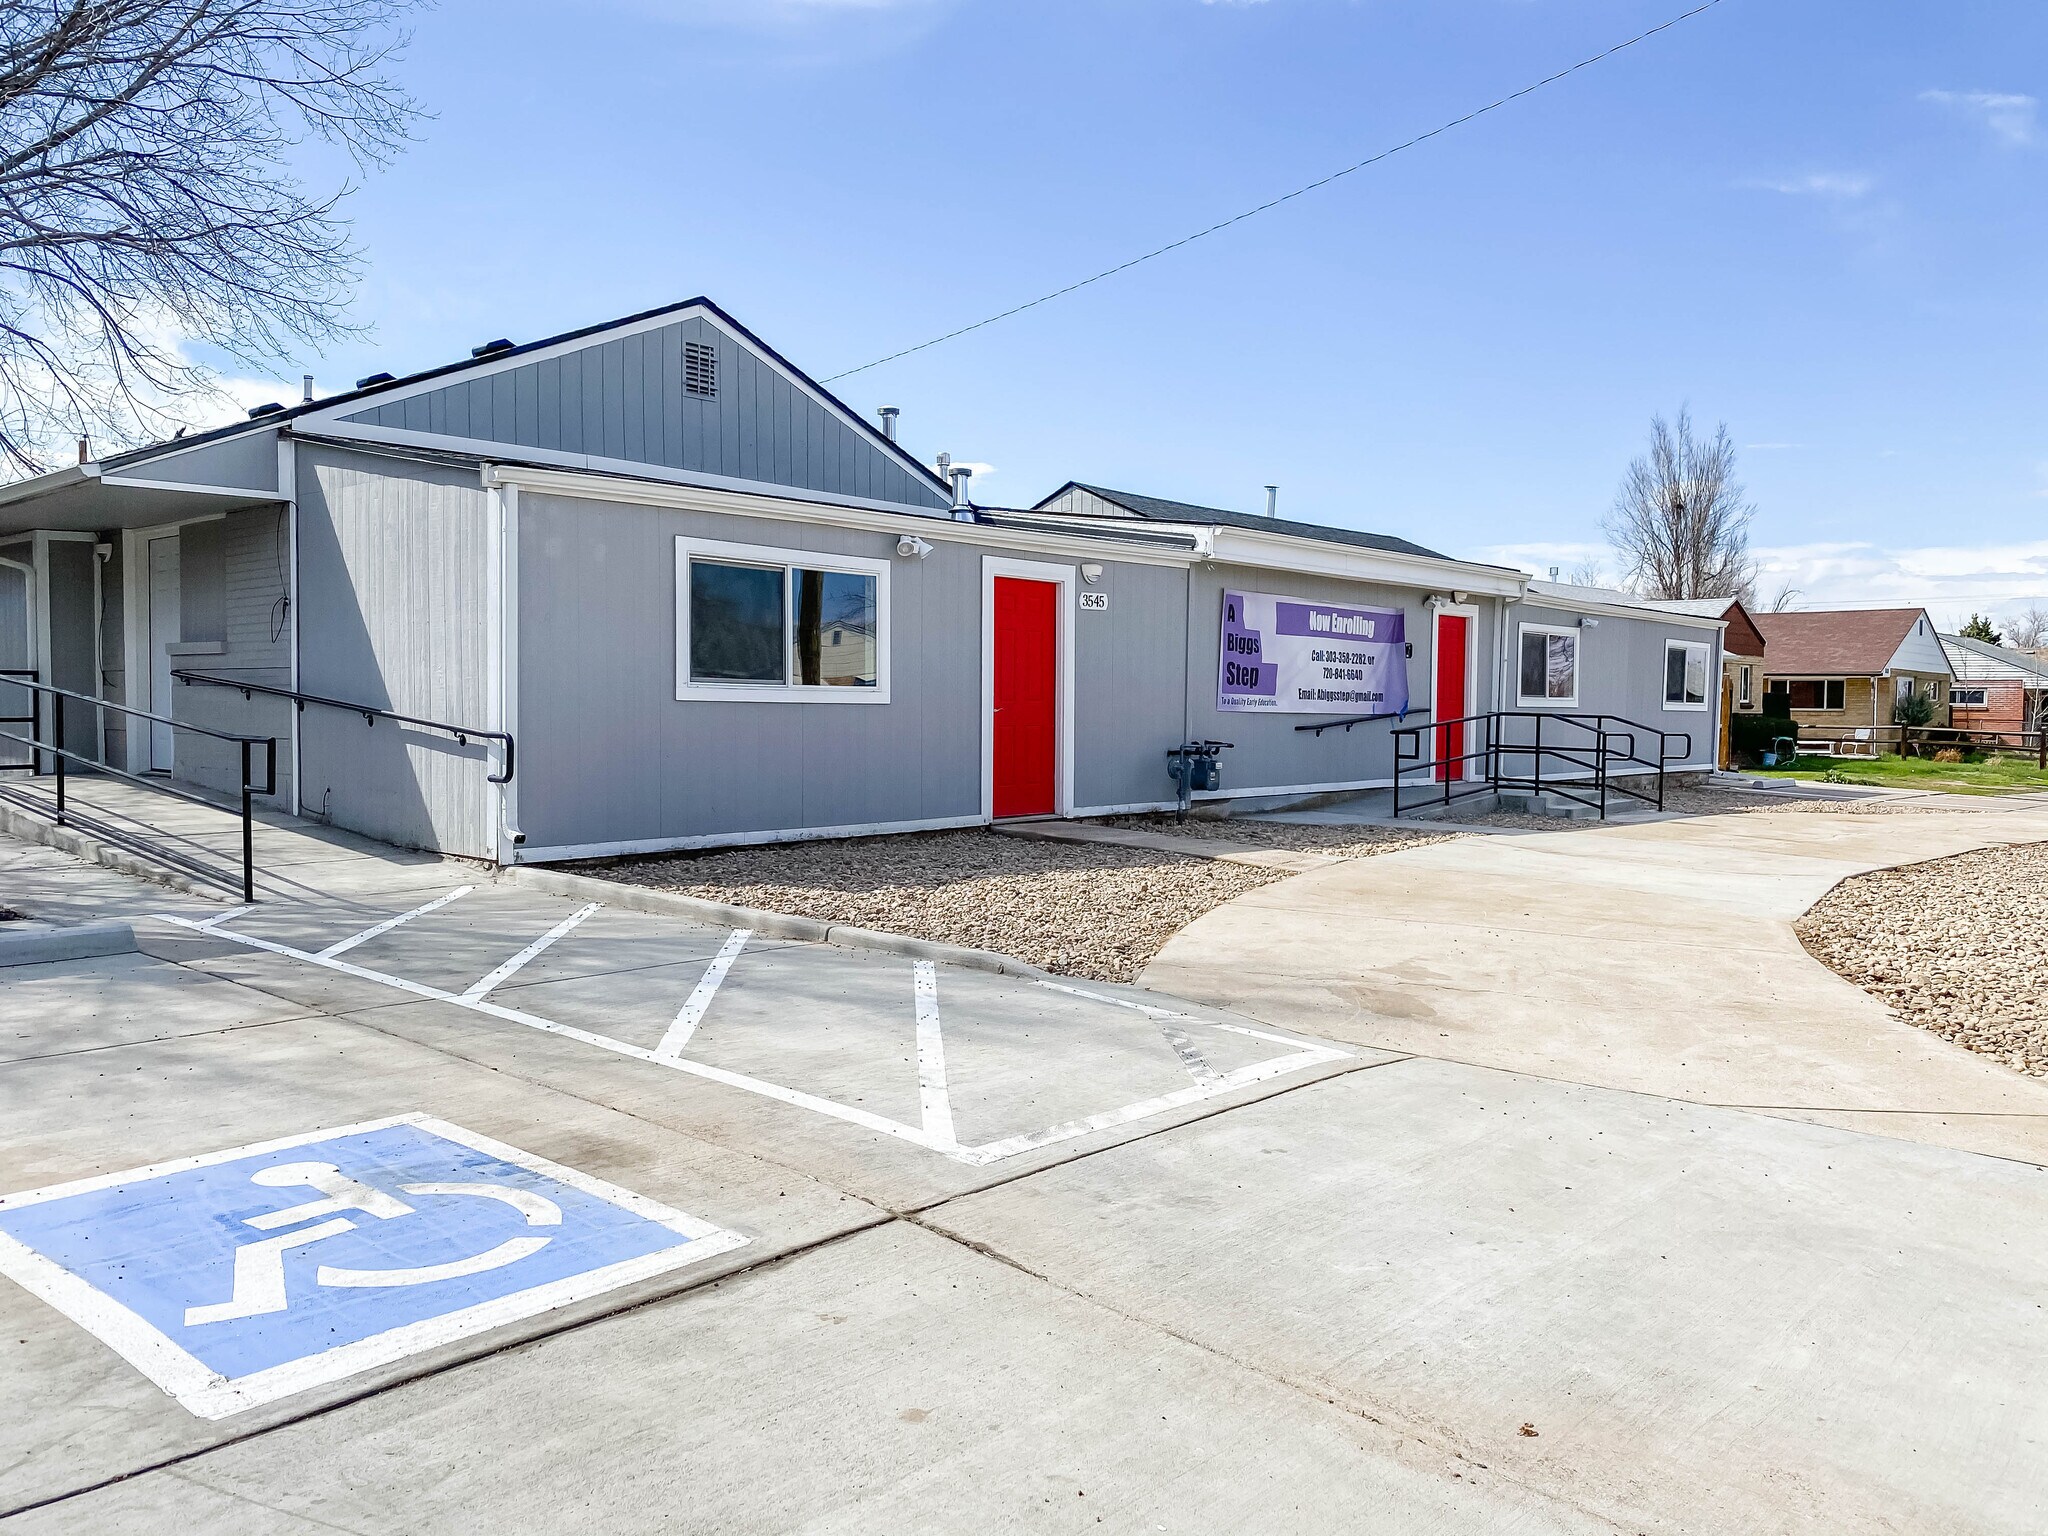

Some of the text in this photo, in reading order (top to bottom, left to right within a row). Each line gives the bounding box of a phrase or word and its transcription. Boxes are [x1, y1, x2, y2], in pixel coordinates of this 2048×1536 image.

[1082, 594, 1105, 608] 3545
[1227, 604, 1235, 622] A
[1309, 610, 1375, 639] Now Enrolling
[1227, 632, 1260, 655] Biggs
[1367, 655, 1375, 665] or
[1226, 661, 1259, 689] Step
[1221, 697, 1227, 705] To
[1231, 697, 1246, 707] Quality
[1246, 697, 1257, 707] Early
[1298, 688, 1316, 700] Email:
